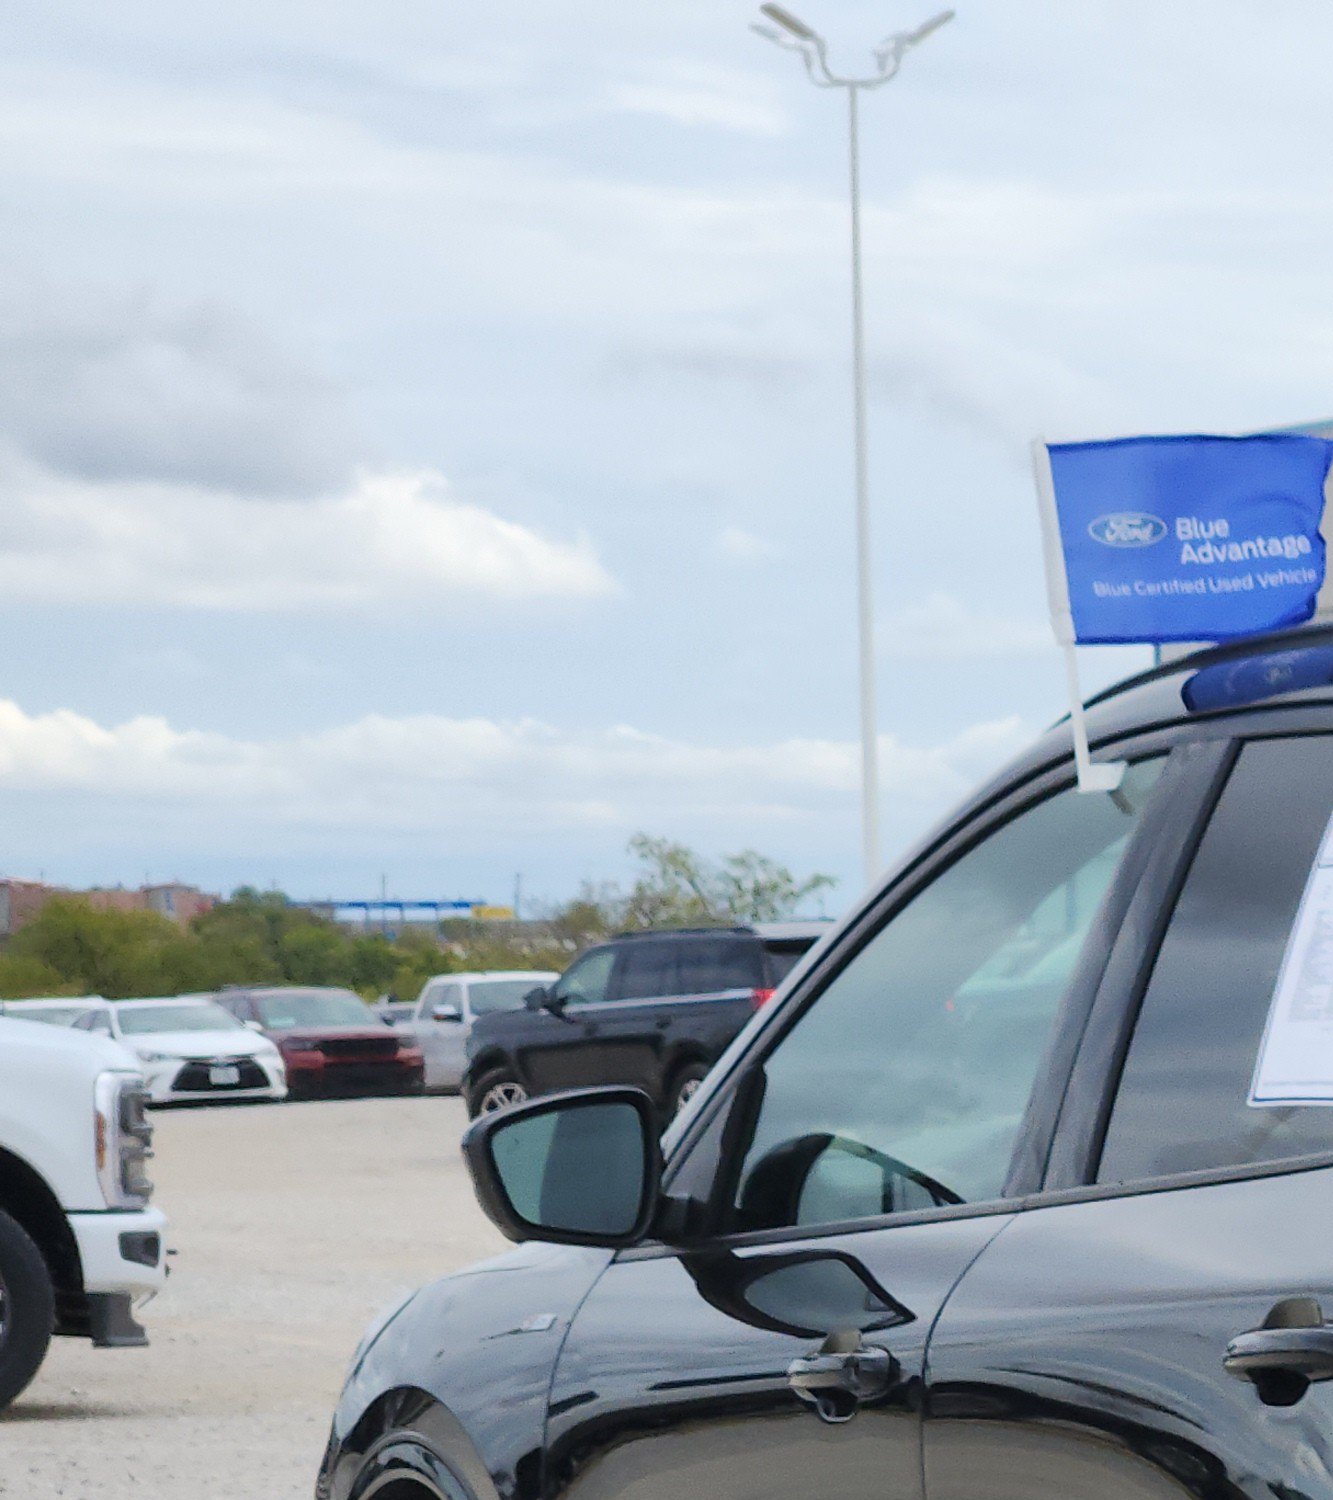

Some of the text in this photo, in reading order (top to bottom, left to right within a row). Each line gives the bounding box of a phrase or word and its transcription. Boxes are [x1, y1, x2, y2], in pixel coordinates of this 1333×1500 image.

[1174, 516, 1230, 541] Blue
[1180, 533, 1312, 565] Advantage
[1093, 567, 1317, 597] Blue Certified Used Vehicle
